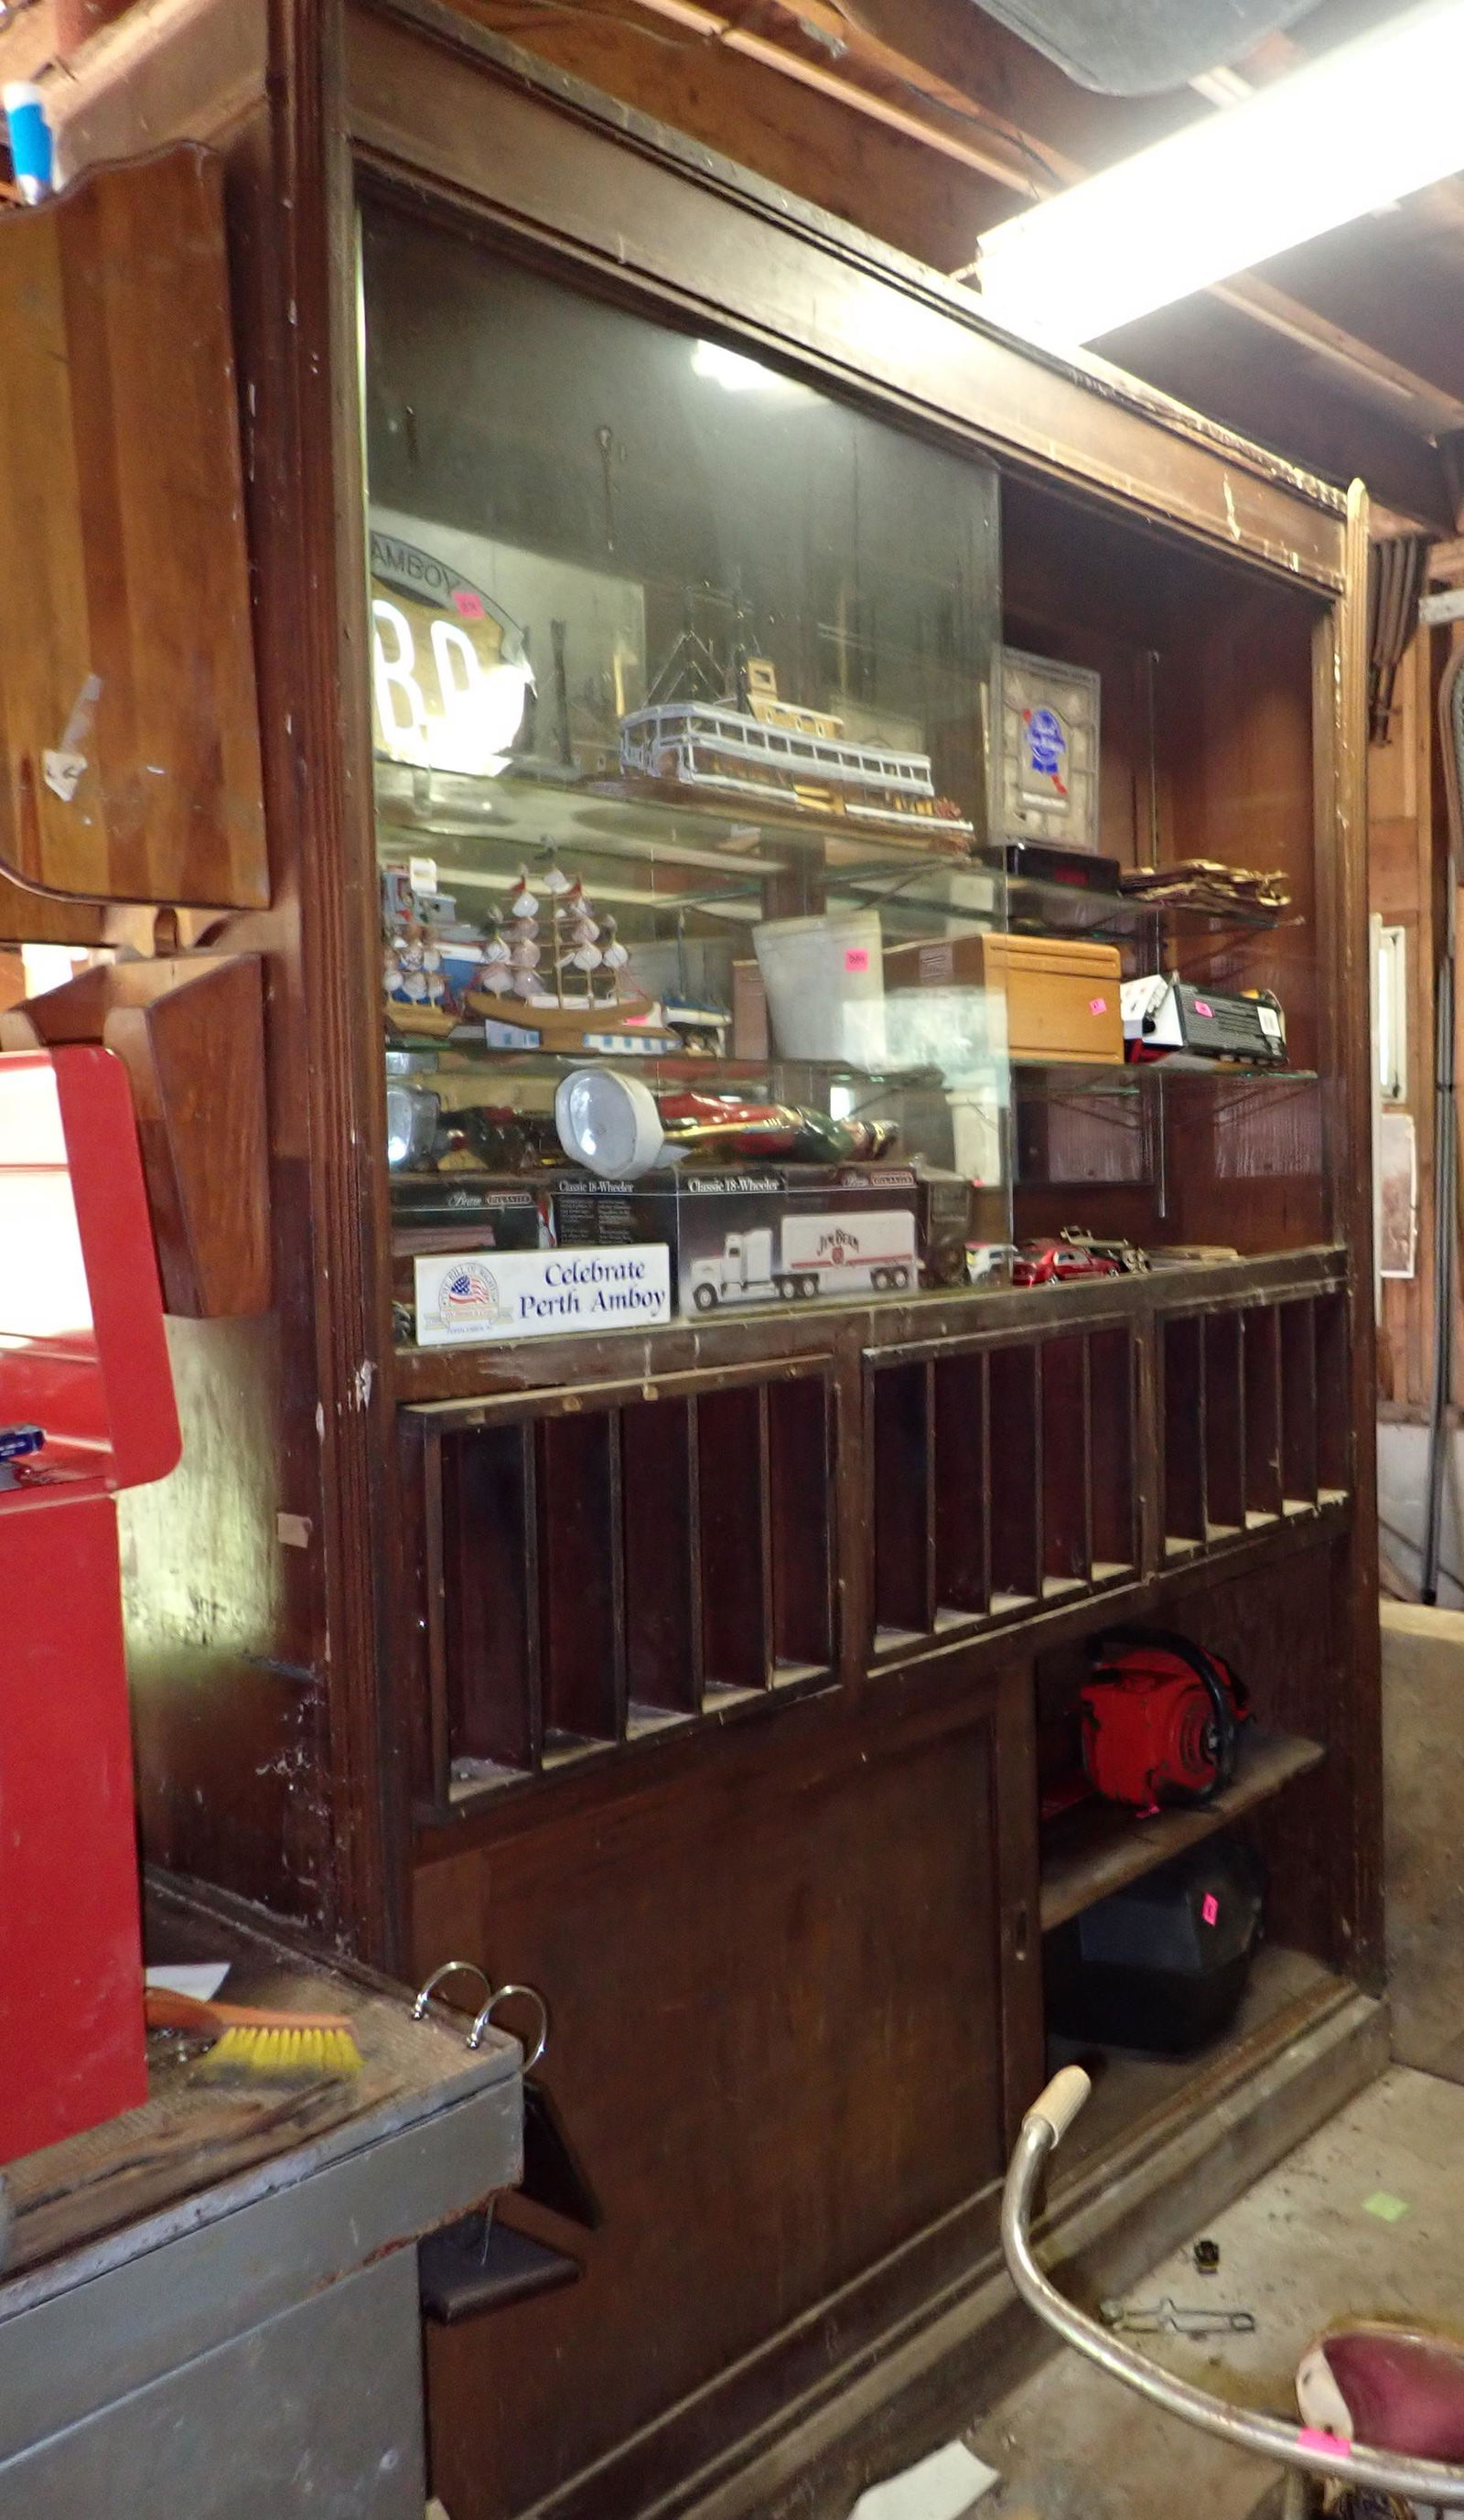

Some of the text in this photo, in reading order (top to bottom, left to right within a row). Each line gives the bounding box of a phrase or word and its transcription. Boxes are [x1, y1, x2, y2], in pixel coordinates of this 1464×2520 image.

[688, 1177, 724, 1193] Classic
[544, 1256, 645, 1287] Celebrate
[519, 1283, 665, 1319] Perth Amboy
